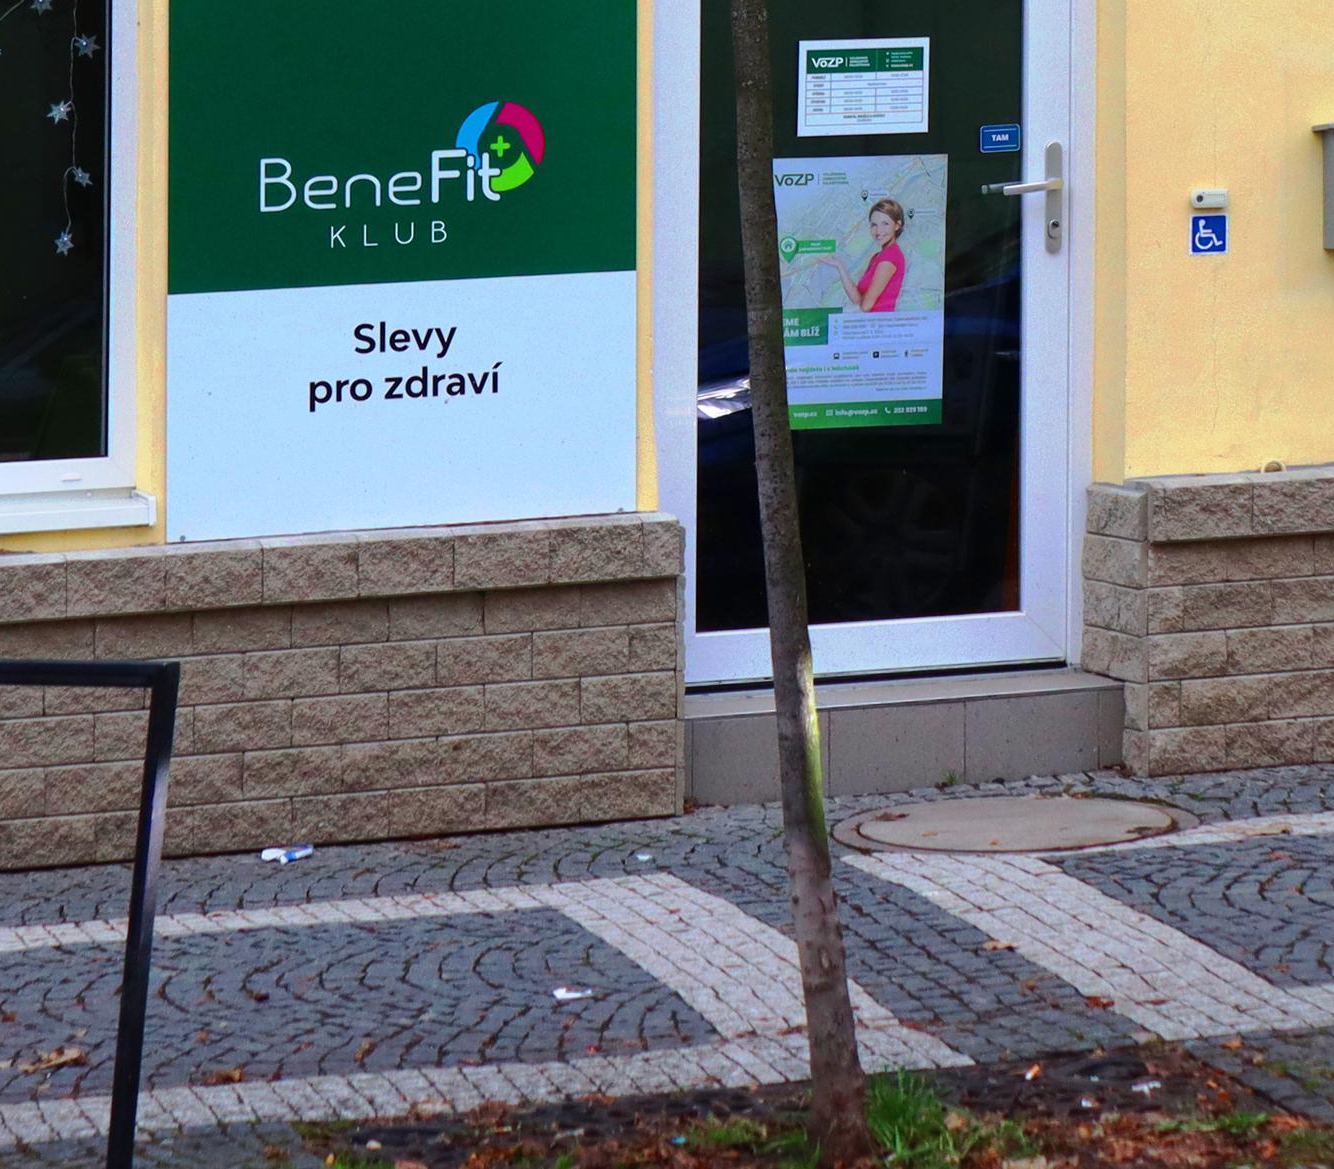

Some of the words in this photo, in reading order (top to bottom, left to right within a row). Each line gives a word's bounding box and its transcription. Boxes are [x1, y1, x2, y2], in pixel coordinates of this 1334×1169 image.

[991, 134, 1009, 142] TAM
[259, 149, 502, 212] BeneFit
[329, 220, 448, 249] KLUB
[353, 322, 457, 359] Slevy
[784, 326, 799, 337] ÁM
[308, 374, 373, 412] pro
[384, 362, 503, 400] zdraví
